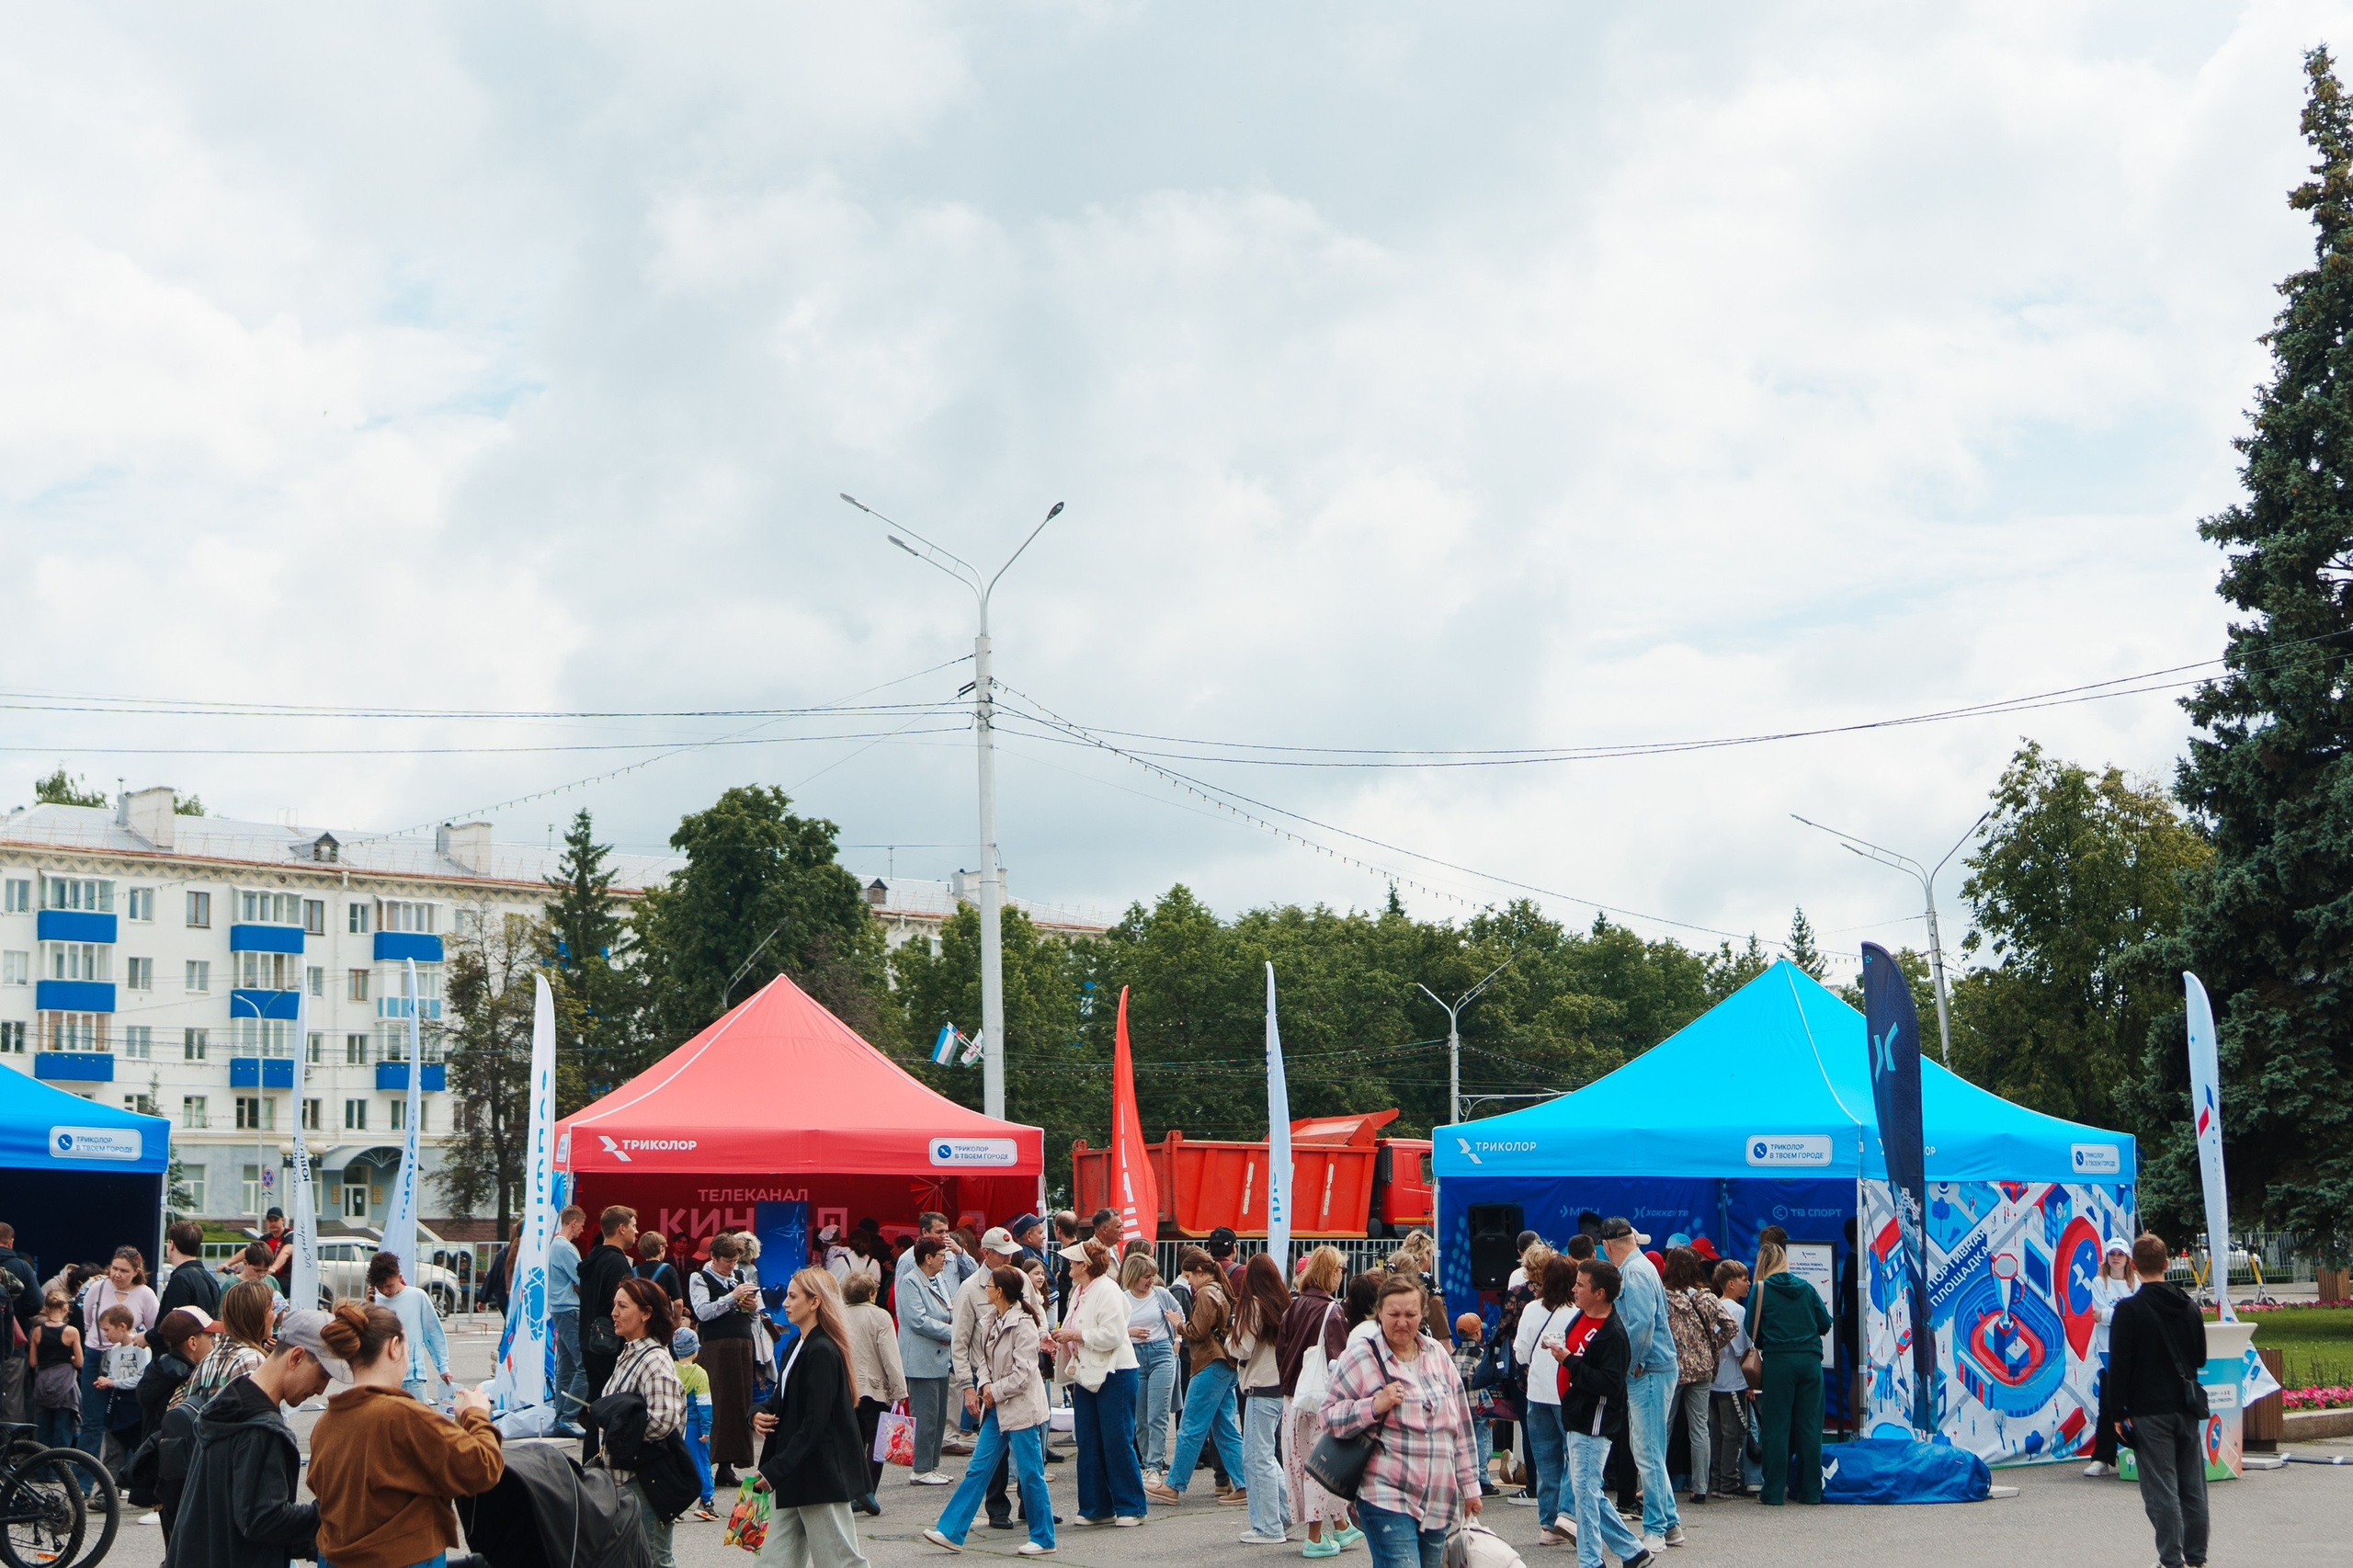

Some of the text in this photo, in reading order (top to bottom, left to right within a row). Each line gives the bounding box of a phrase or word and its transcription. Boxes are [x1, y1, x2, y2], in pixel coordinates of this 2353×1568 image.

[107, 1145, 133, 1153] ГОРОДЕ
[621, 1140, 698, 1151] ТРИКОЛОР
[1475, 1142, 1537, 1152] ТРИКОЛОР
[698, 1188, 809, 1202] ТЕЛЕКАНАЛ
[1790, 1209, 1806, 1217] ТВ
[1807, 1209, 1842, 1217] СПОРТ
[1927, 1227, 1987, 1292] ПОРТИВНАЯ
[1929, 1245, 1992, 1307] ПЛОЩАДКА
